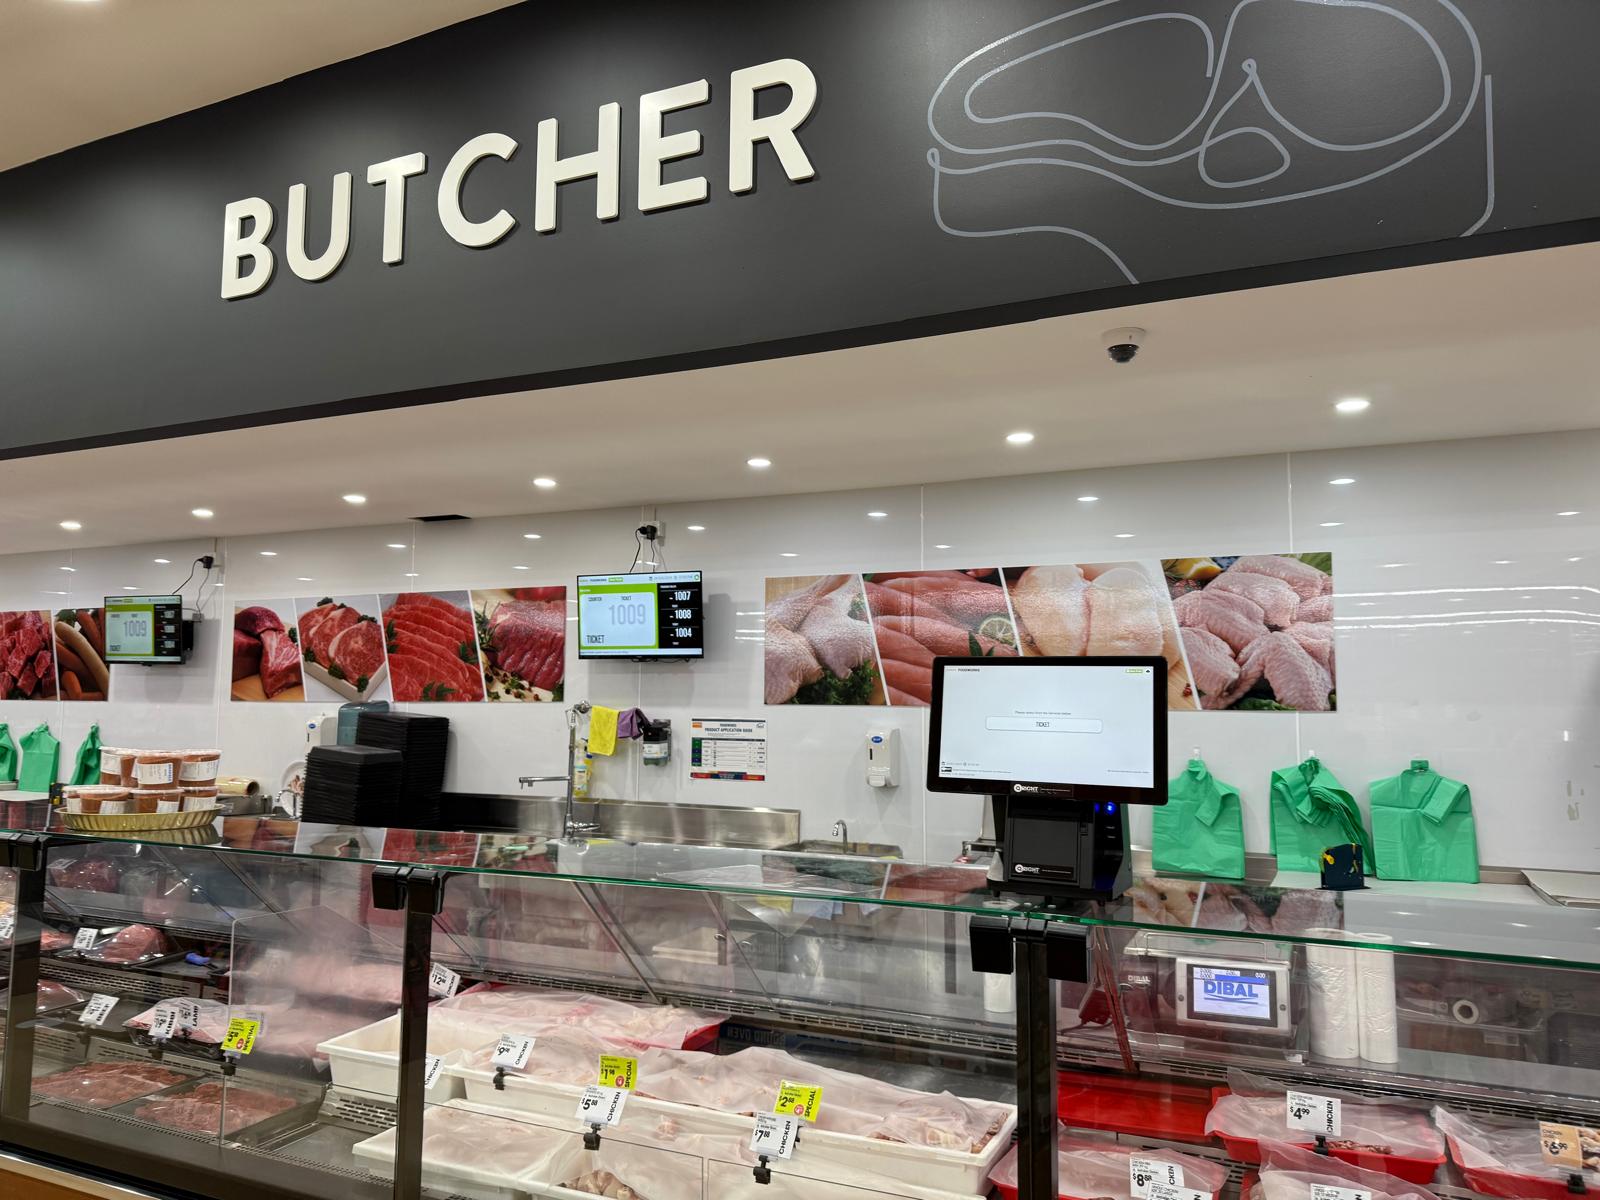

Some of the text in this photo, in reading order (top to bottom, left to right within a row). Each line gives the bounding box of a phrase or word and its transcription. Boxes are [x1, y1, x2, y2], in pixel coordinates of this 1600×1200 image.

[221, 58, 817, 299] BUTCHER
[674, 591, 691, 601] 1007
[608, 604, 646, 625] 1009
[587, 634, 605, 644] TICKET
[675, 628, 692, 638] 1004
[1204, 980, 1259, 998] DIBAL
[242, 1024, 255, 1051] SPECIAL
[515, 1041, 529, 1065] CHICKEN
[624, 1061, 632, 1088] SPECIAL
[607, 1092, 621, 1122] CHICKEN
[805, 1090, 816, 1117] SPECIAL
[779, 1120, 791, 1155] CHICKEN
